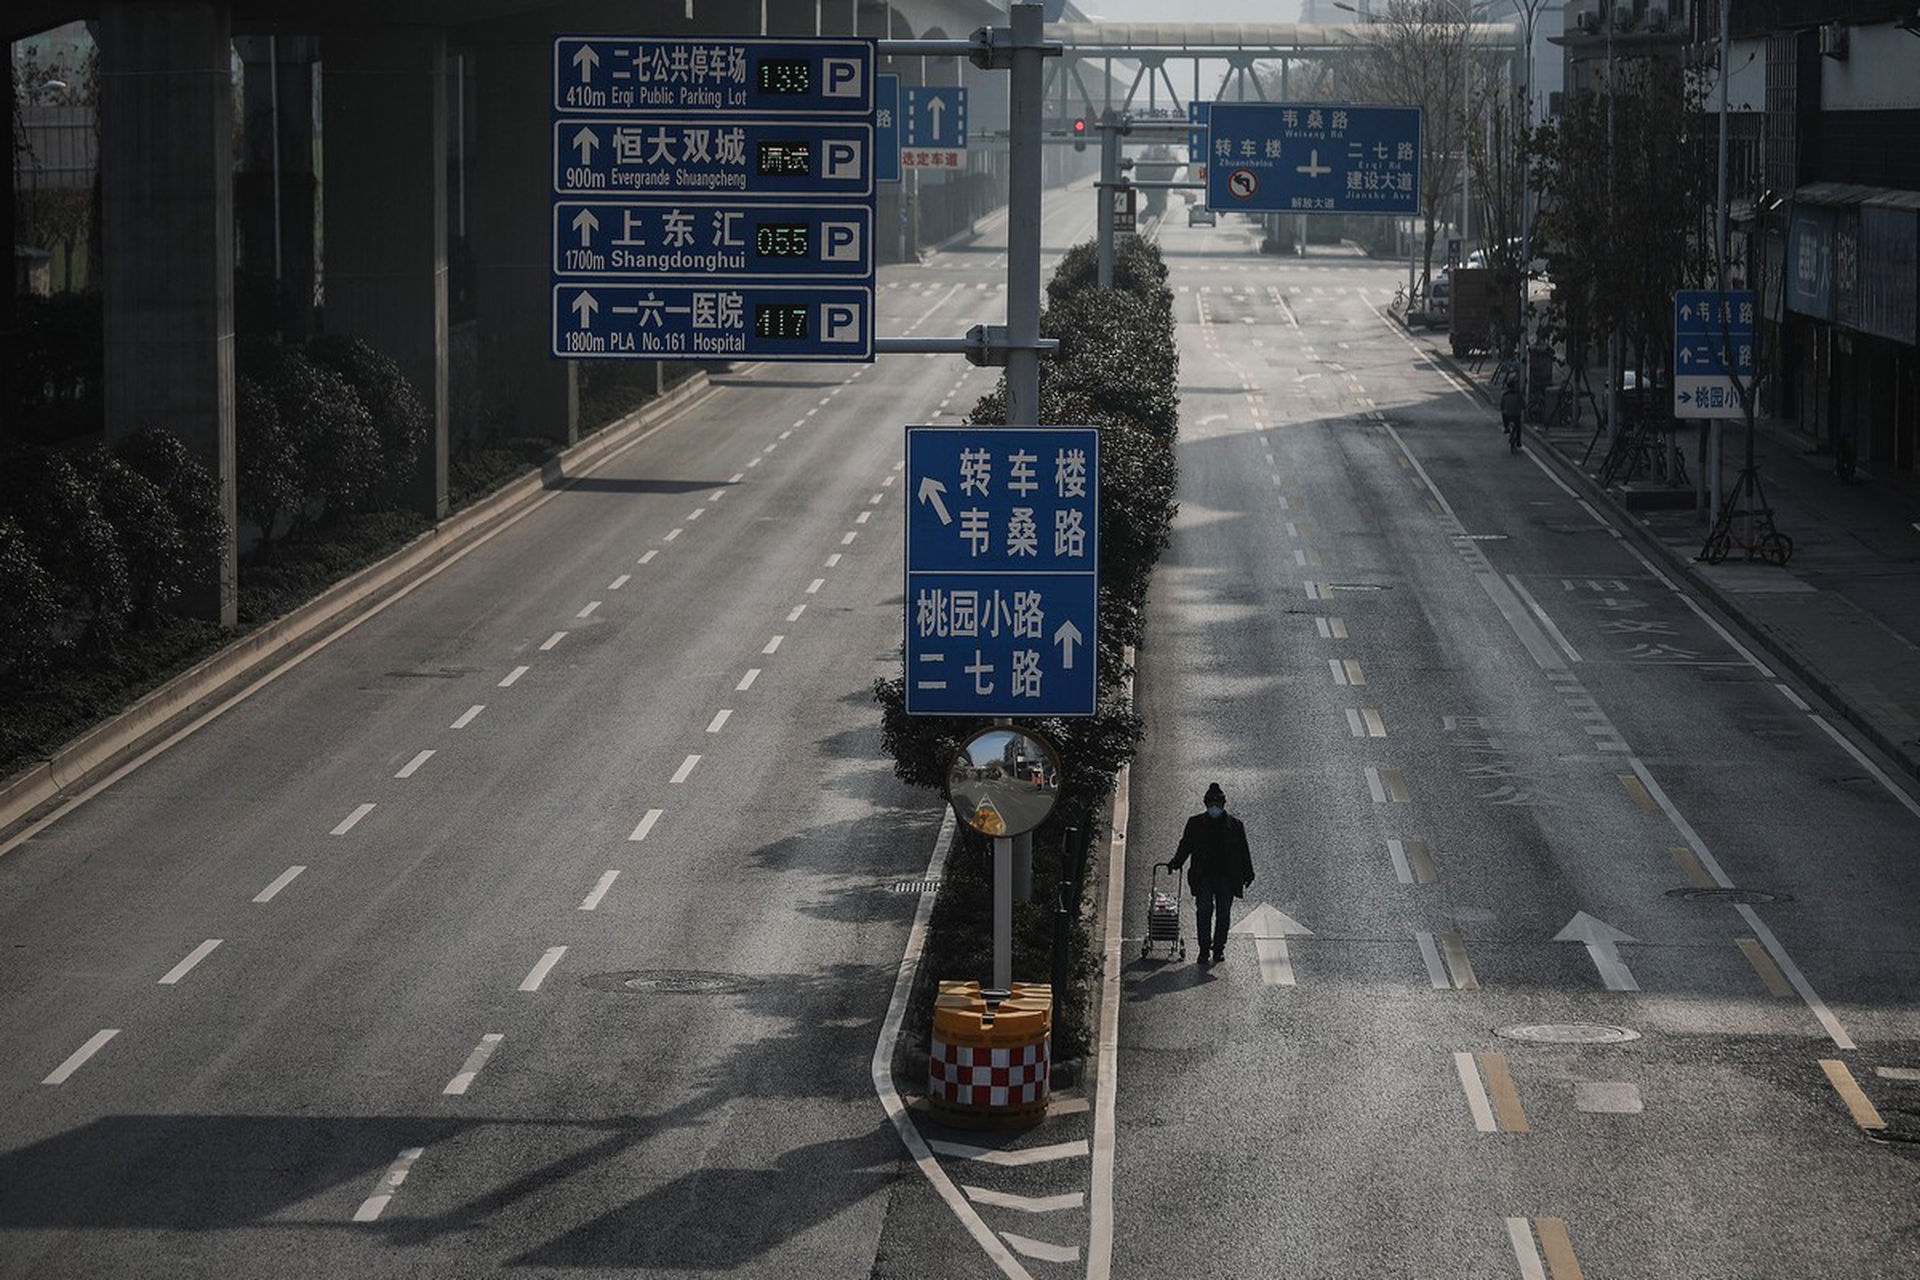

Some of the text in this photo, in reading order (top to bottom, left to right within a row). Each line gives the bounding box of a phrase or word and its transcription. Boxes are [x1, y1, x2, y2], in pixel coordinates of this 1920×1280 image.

[612, 46, 747, 84] 二七公共停车场
[566, 87, 606, 106] 410m
[612, 87, 747, 109] Erqi Public Parking Lot
[1282, 109, 1348, 129] 韦桑路
[612, 127, 747, 166] 恒大双城
[1215, 138, 1282, 158] 转车楼
[1348, 141, 1413, 160] 二七路
[902, 151, 958, 167] 选定车道
[566, 171, 606, 189] 900m
[611, 168, 747, 190] Evergrande Shuangcheng
[1346, 171, 1413, 191] 建设大道
[1290, 197, 1336, 209] 解放大道
[611, 208, 746, 248] 上东汇
[757, 228, 808, 256] 055
[565, 250, 605, 270] 1700m
[611, 250, 746, 271] Shangdonghui
[611, 291, 745, 330] 一六一医院
[565, 332, 605, 353] 1800m
[610, 332, 746, 353] PLA No.161 Hospital
[1695, 386, 1751, 409] 桃园小
[959, 447, 1087, 499] 转车楼
[959, 506, 1086, 558] 韦桑路
[916, 588, 1045, 640] 桃园小路
[918, 649, 1044, 699] 二七路
